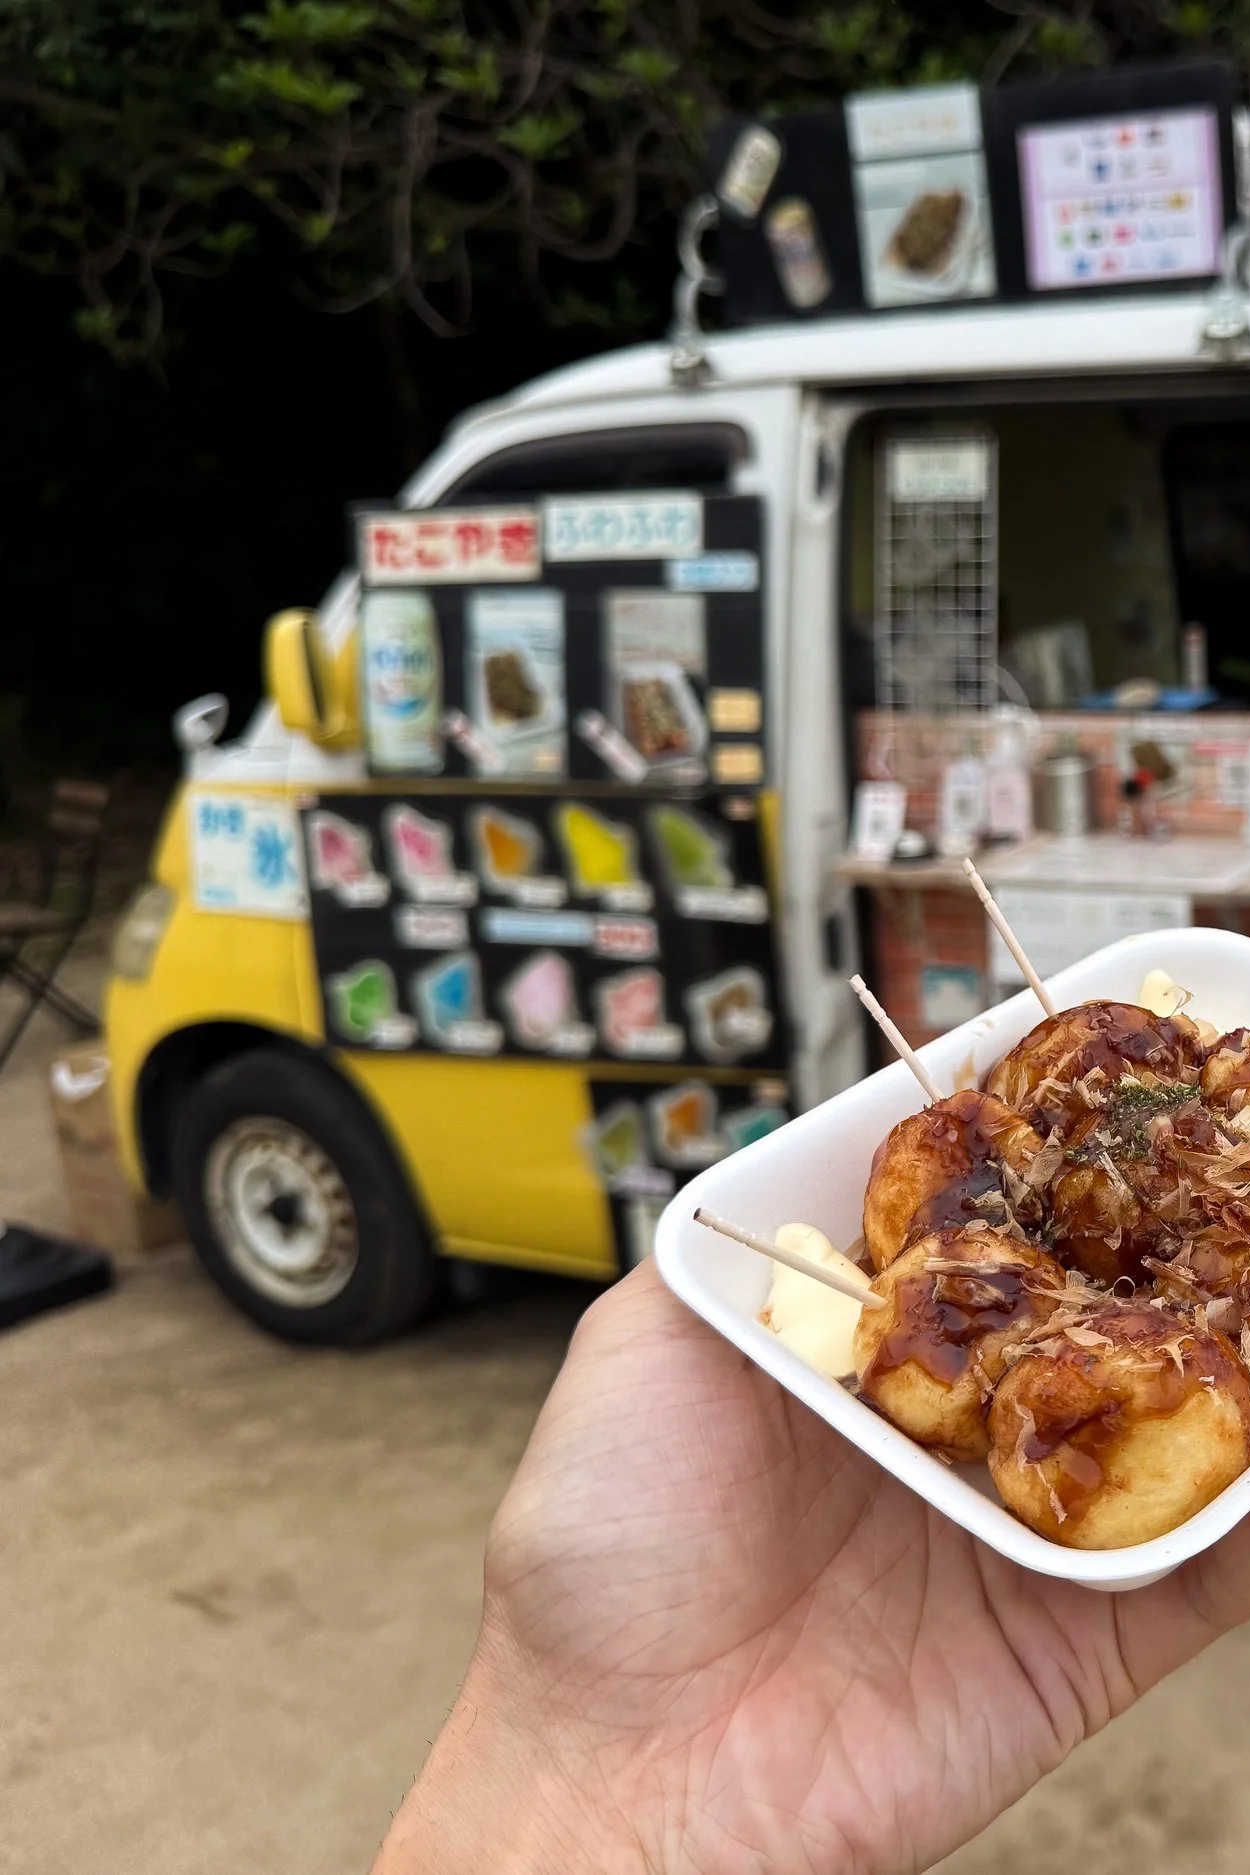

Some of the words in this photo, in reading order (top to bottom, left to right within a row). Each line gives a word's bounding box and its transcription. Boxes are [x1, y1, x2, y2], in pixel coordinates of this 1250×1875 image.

[368, 517, 539, 571] たこやき
[555, 505, 701, 550] ふわふわ
